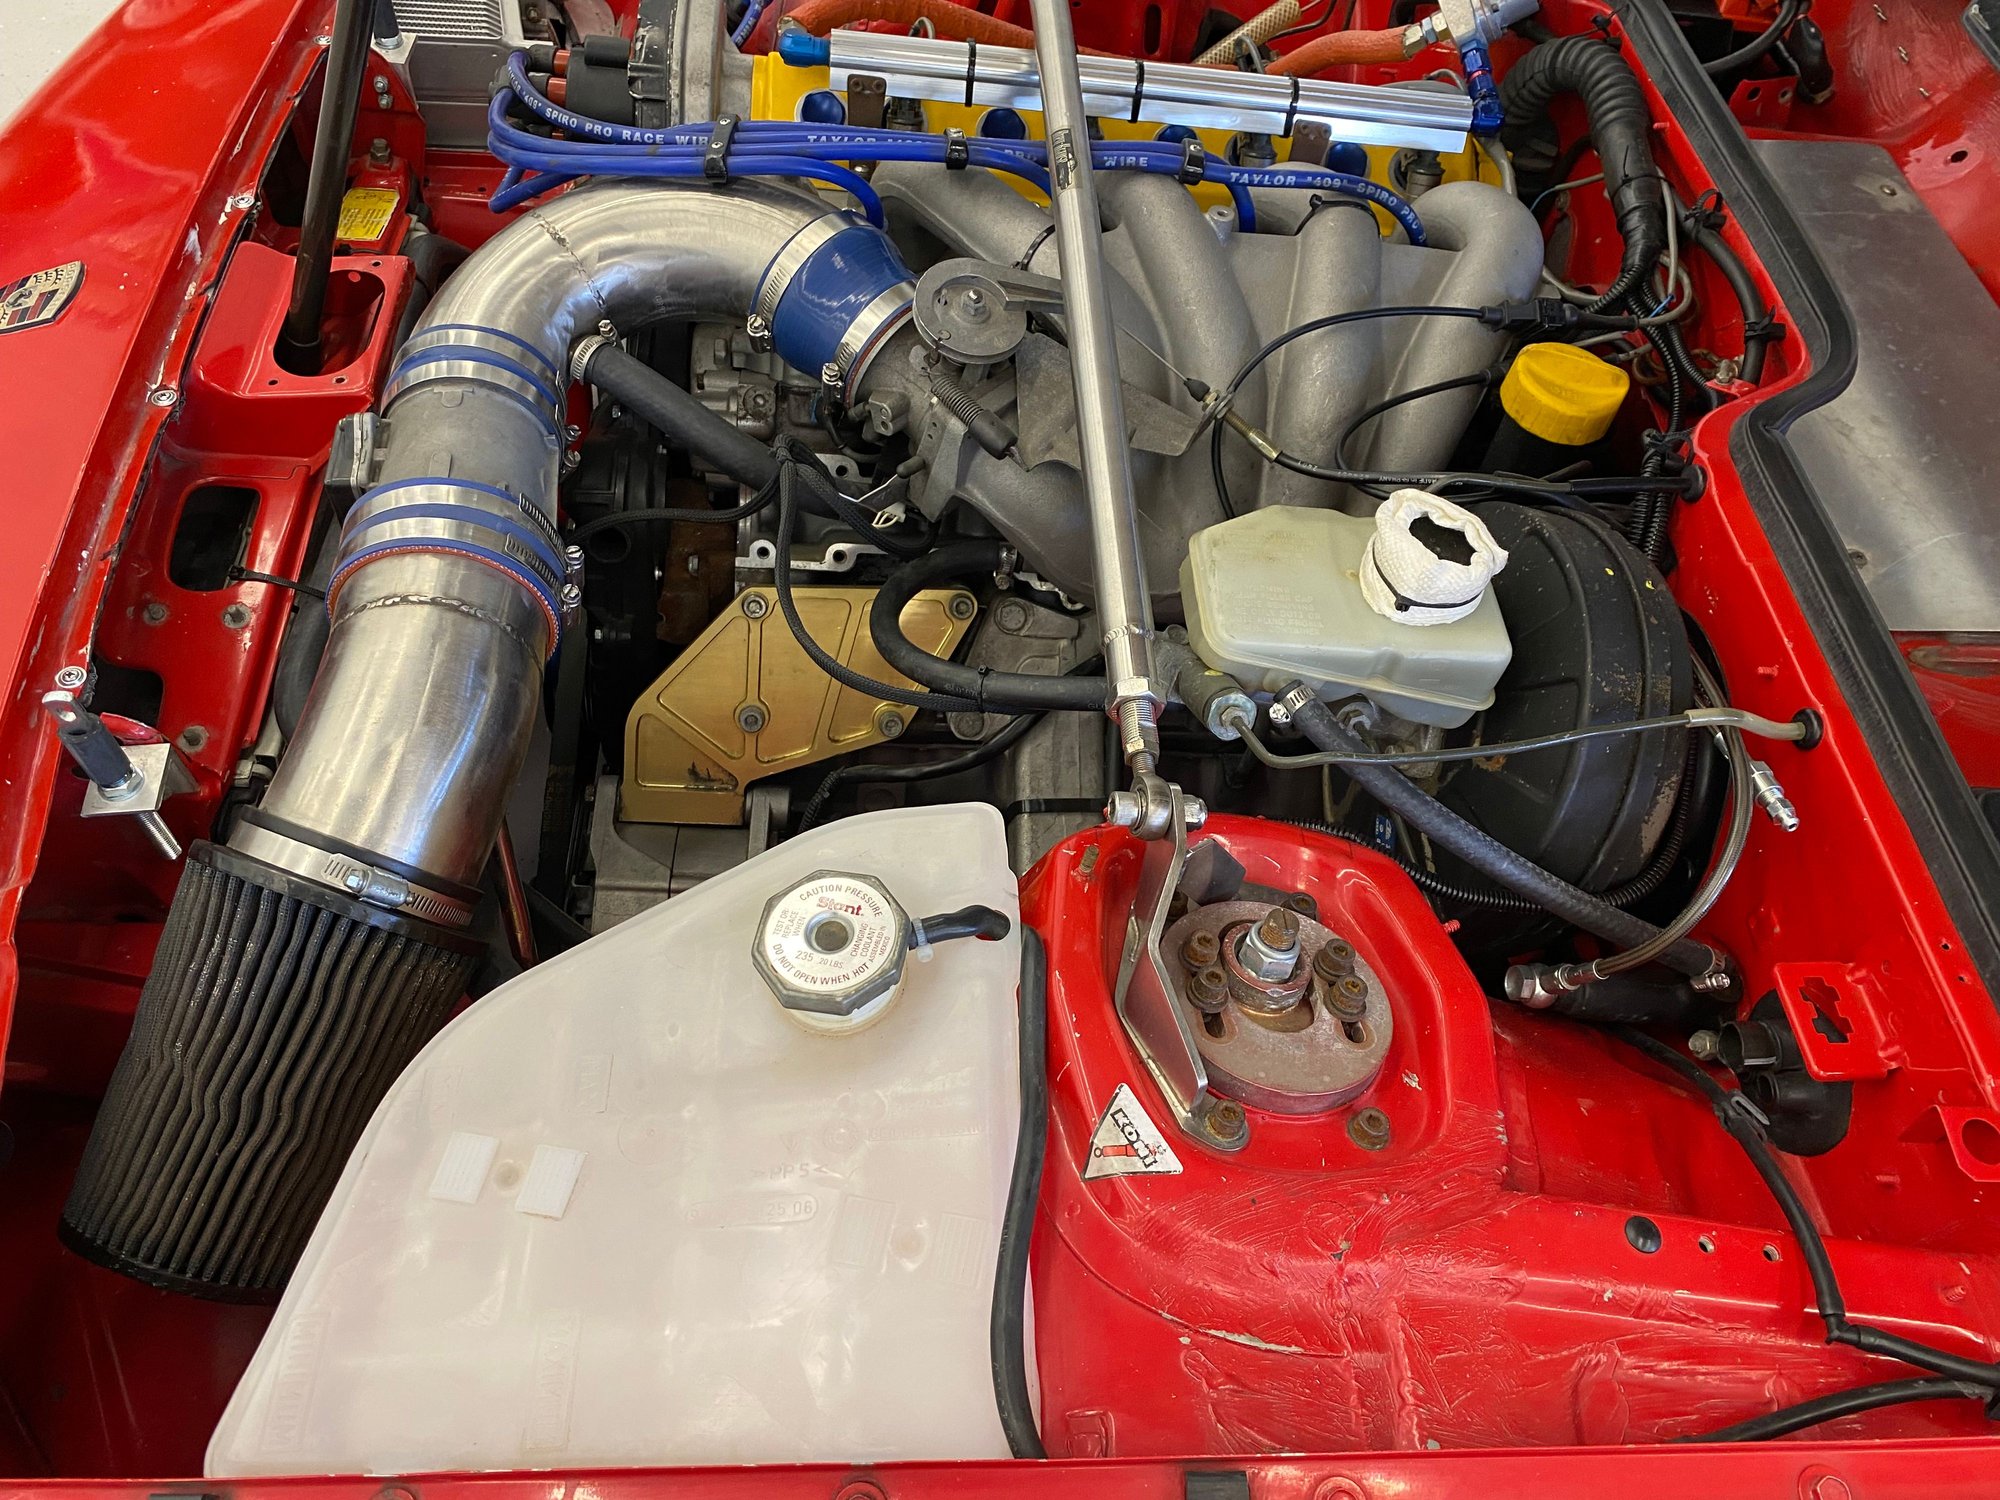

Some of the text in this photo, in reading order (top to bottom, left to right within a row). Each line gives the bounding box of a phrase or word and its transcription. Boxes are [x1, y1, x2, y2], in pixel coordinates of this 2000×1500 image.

[544, 107, 578, 128] SPIRO
[584, 122, 613, 138] PRO
[622, 130, 665, 145] RACE
[1103, 156, 1148, 167] WIRE
[1230, 172, 1296, 186] TAYLOR
[1356, 182, 1398, 207] SPIRO
[799, 884, 883, 918] CAUTION PRESSURE
[817, 896, 864, 916] Stant
[773, 917, 784, 936] TEST
[781, 910, 799, 939] REPLACE
[792, 916, 806, 937] WHEN
[850, 922, 869, 957] CHANGING
[860, 927, 876, 957] COOLANT
[868, 930, 884, 963] ASSEMBLED
[878, 936, 891, 957] MEXICO
[772, 943, 870, 985] DO NOT OPEN WHEN HOT
[795, 950, 844, 969] 235 20 LBS
[1110, 1108, 1158, 1169] KONI
[793, 1200, 812, 1215] 06
